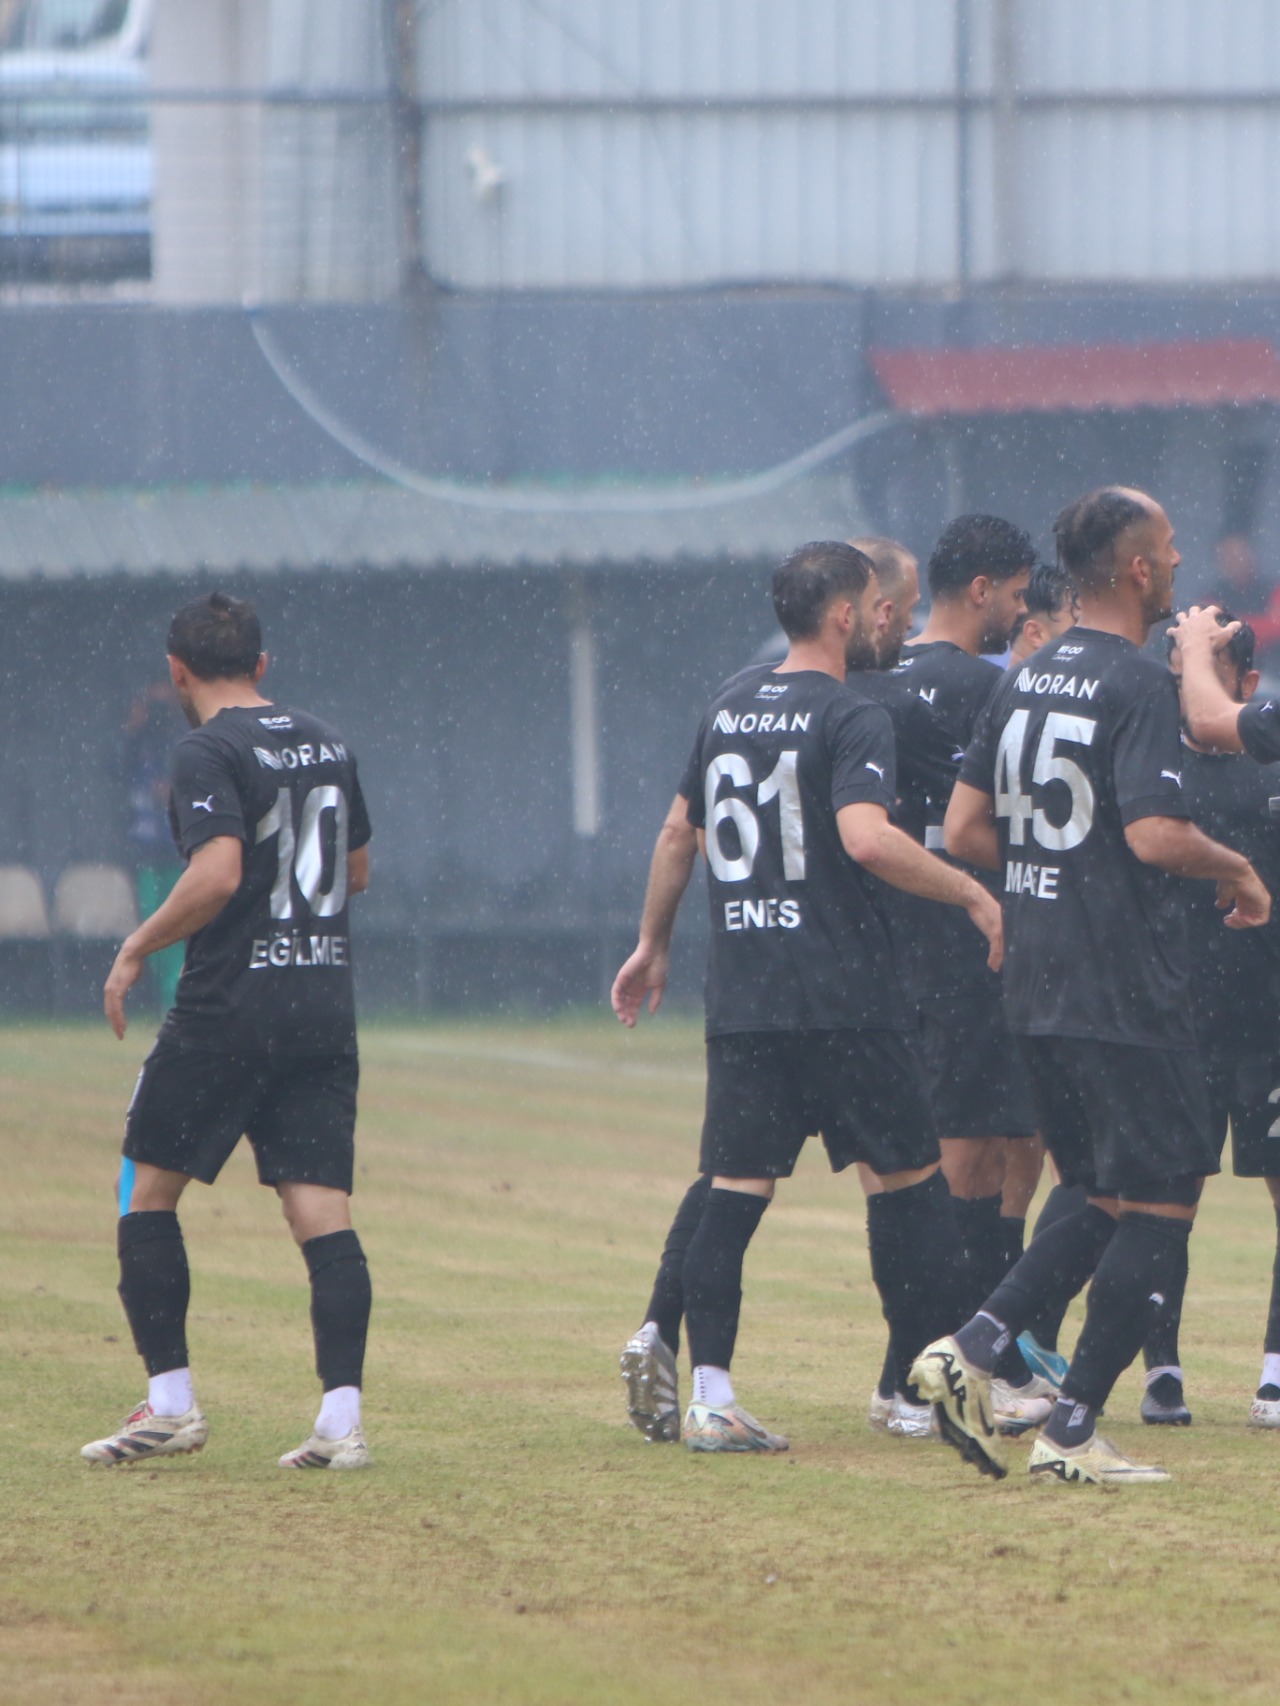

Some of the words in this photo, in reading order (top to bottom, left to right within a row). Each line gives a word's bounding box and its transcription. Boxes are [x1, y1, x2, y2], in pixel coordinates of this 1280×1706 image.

[1014, 667, 1100, 700] NORAN
[713, 710, 811, 734] NORAN
[253, 744, 348, 770] NORAN
[994, 709, 1097, 851] 45
[705, 751, 805, 883] 61
[256, 785, 350, 919] 10
[249, 929, 348, 969] EĞİLME
